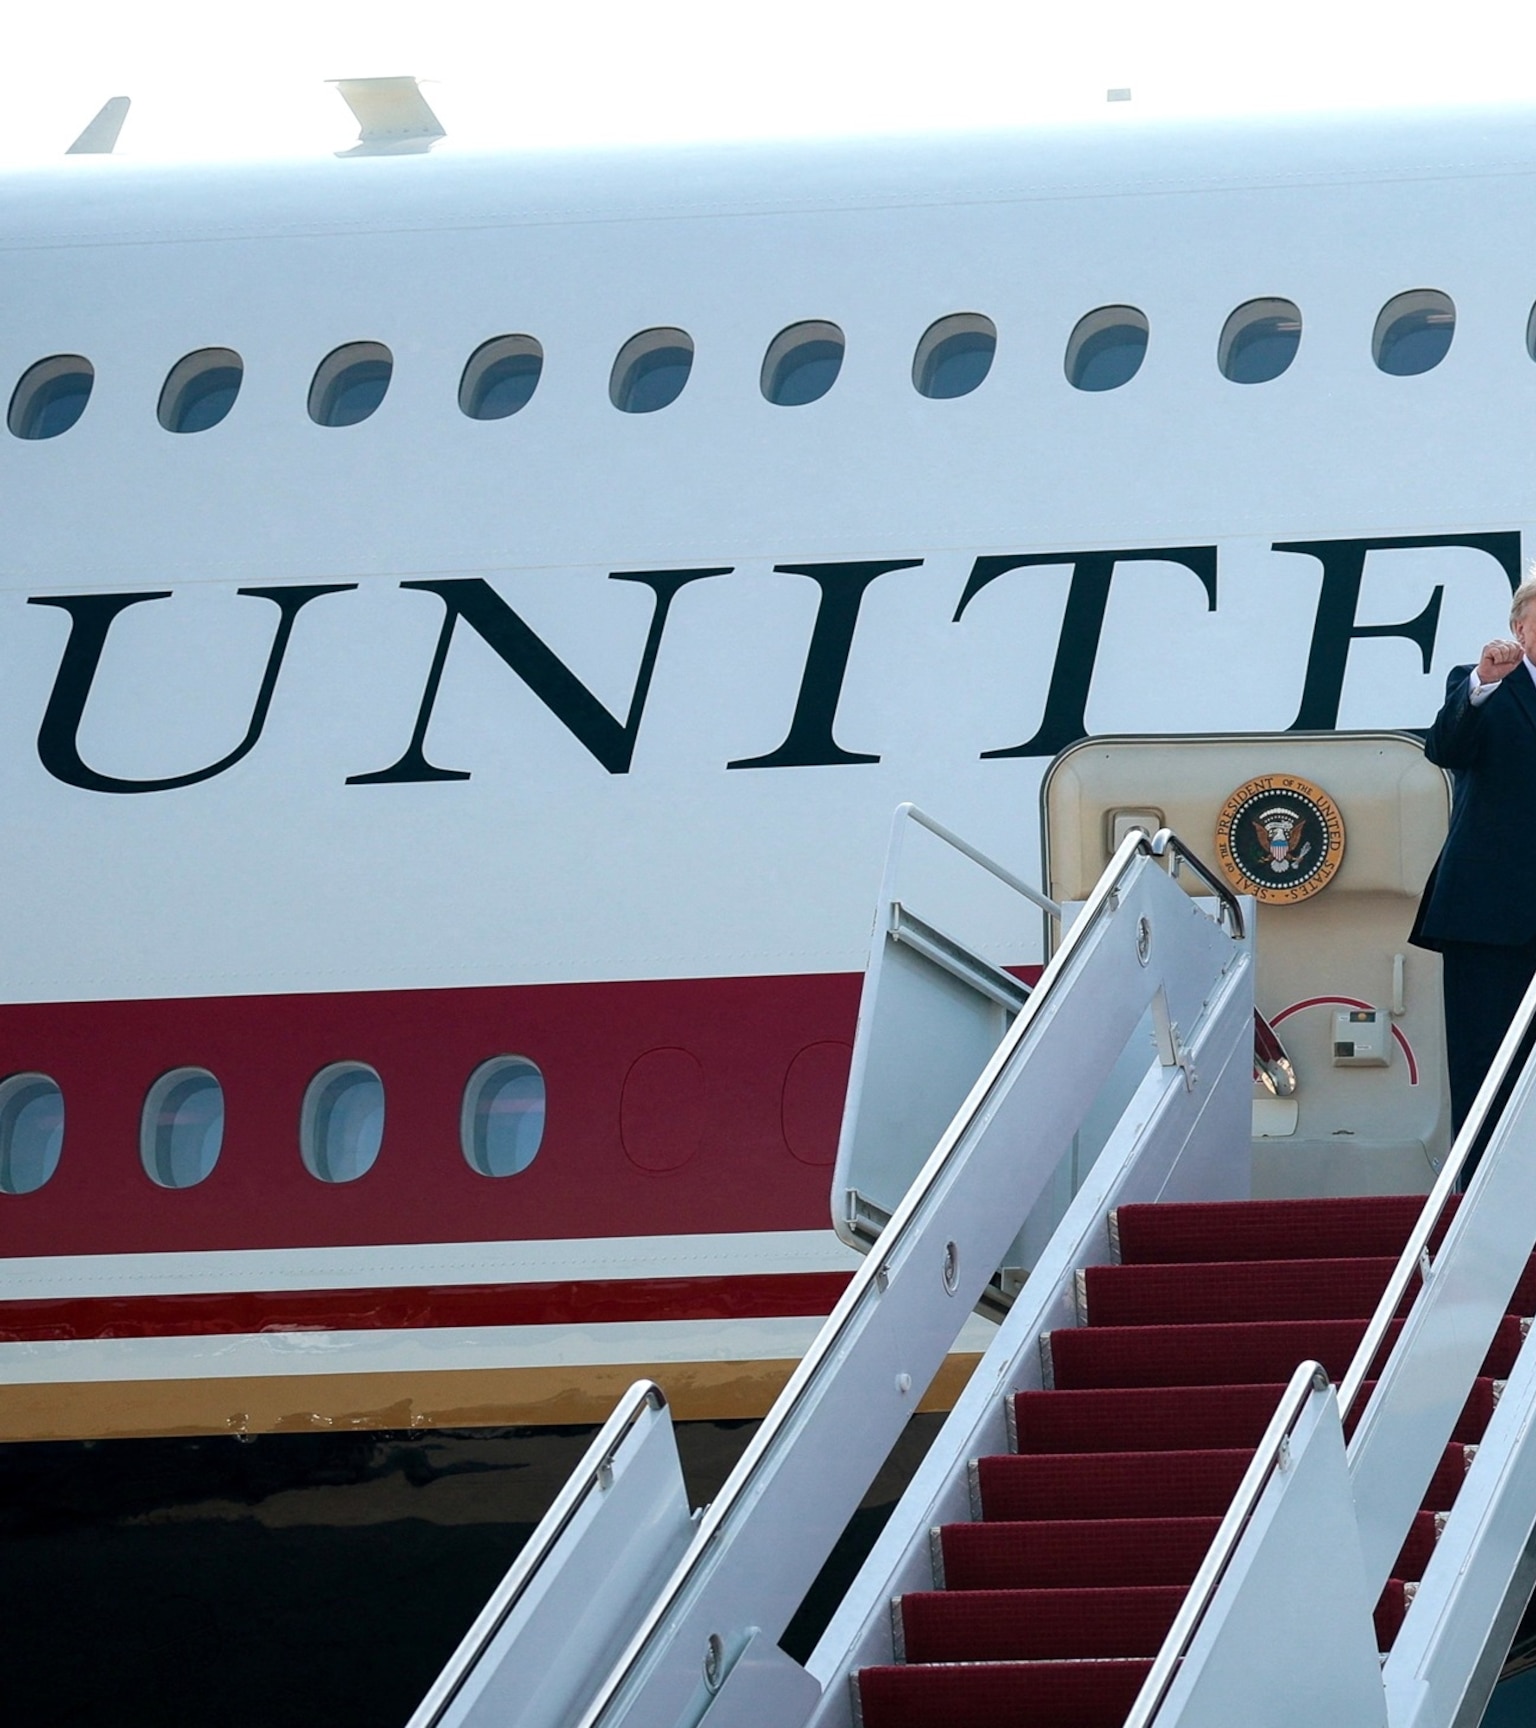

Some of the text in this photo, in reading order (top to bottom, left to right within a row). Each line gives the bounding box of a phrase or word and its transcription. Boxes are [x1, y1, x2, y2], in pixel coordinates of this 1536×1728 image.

[1218, 778, 1341, 899] SEAL OF THE PRESIDENT OF THE UNITED STATES
